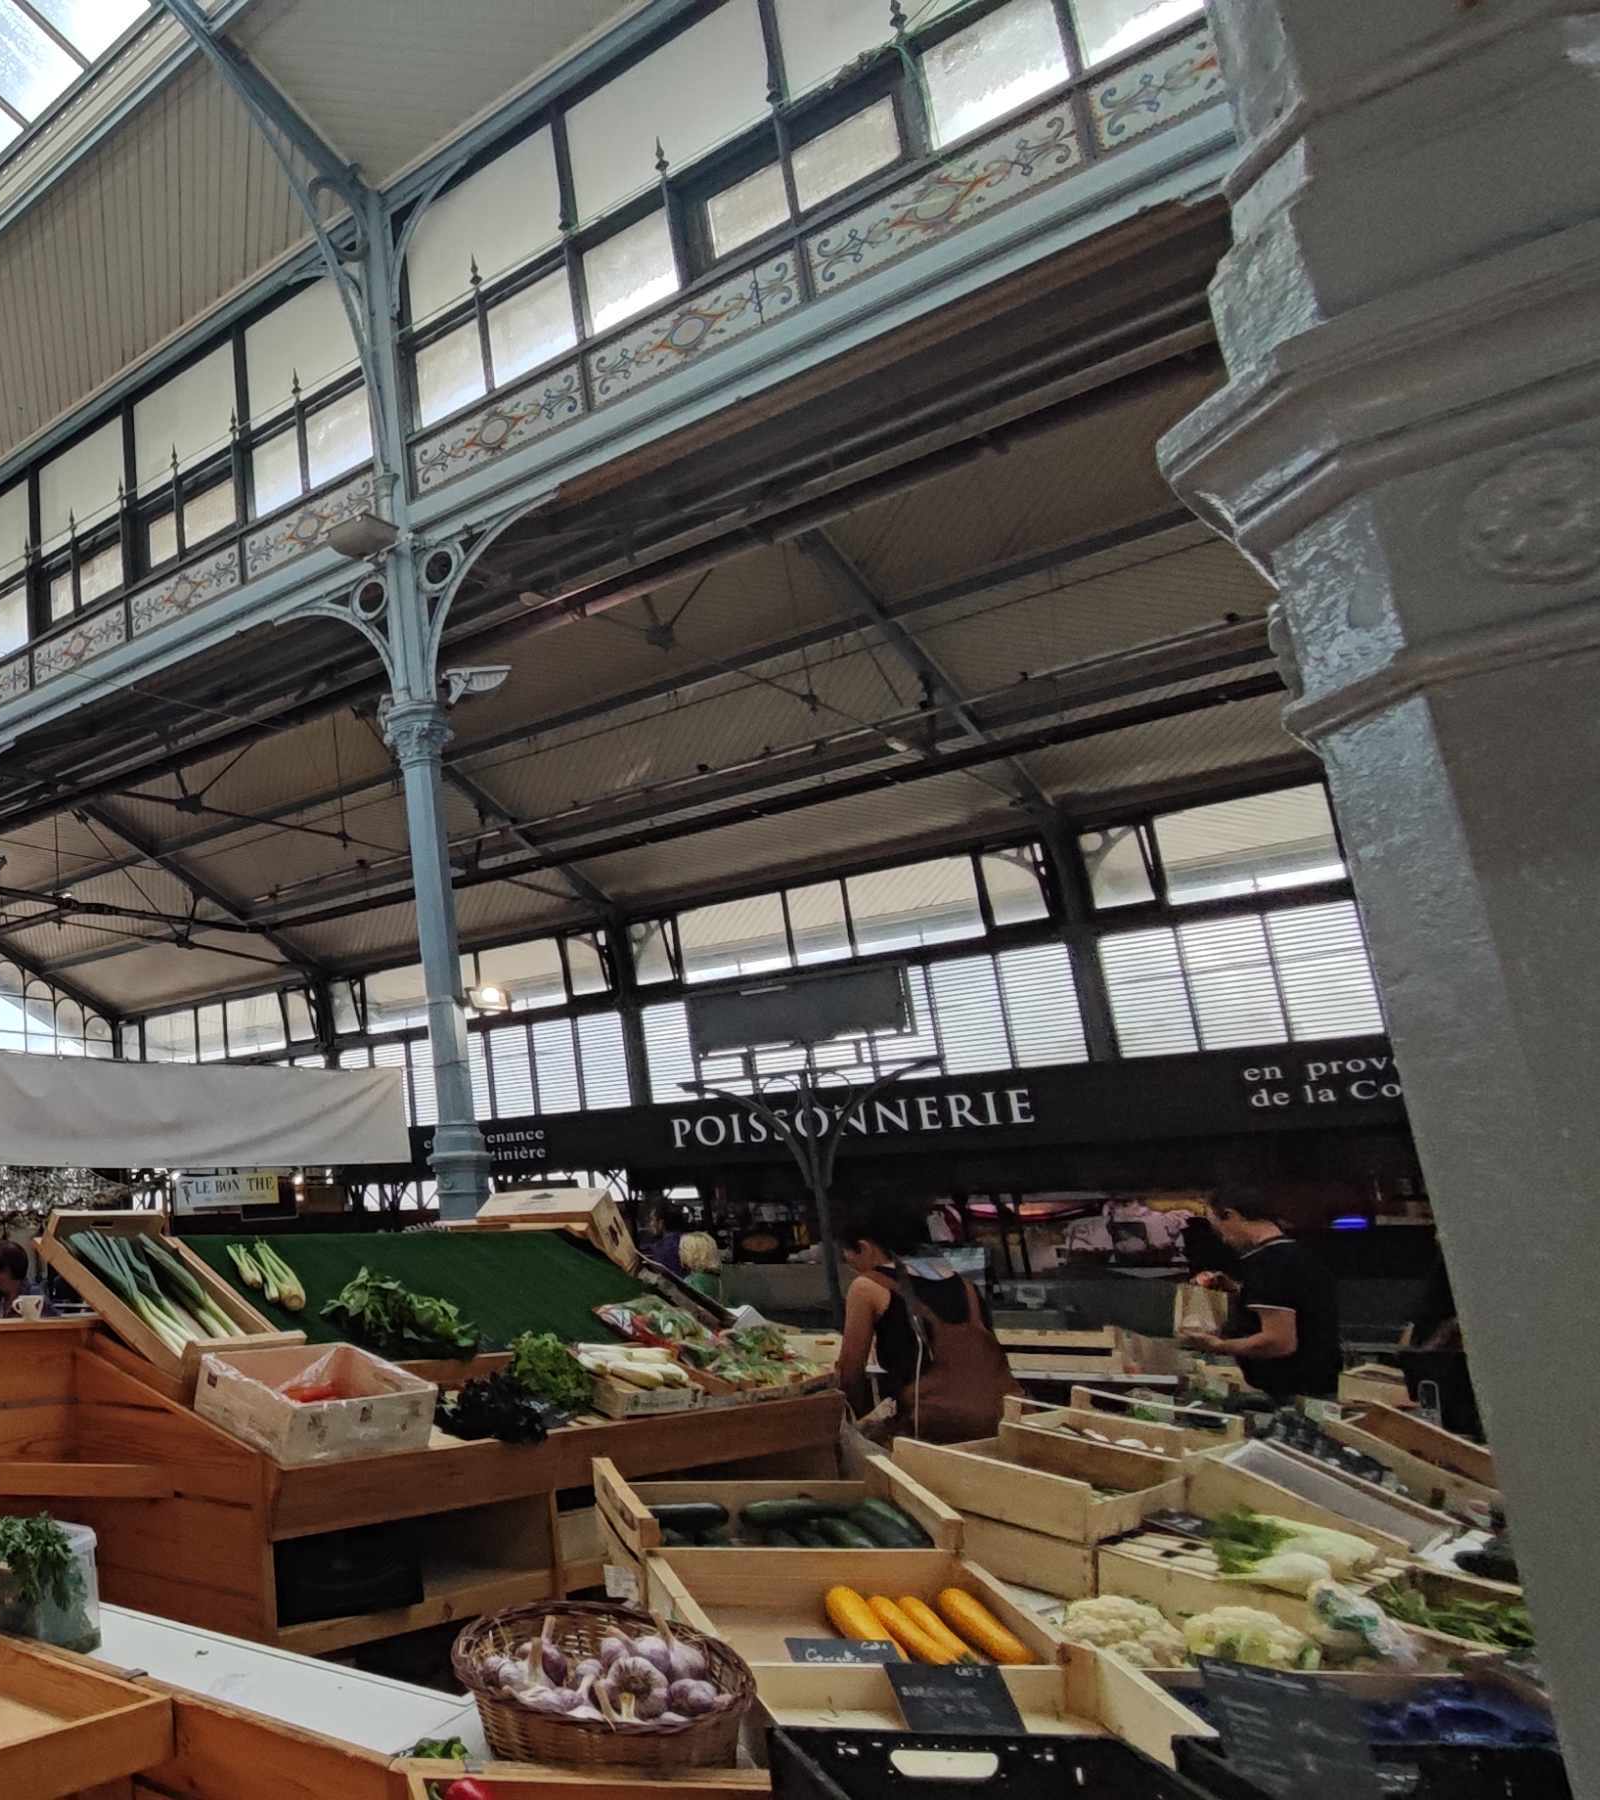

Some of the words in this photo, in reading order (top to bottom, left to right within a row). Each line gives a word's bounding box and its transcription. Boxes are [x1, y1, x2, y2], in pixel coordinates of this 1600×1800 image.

[1243, 1066, 1283, 1081] en
[1306, 1057, 1387, 1081] prov
[1251, 1089, 1290, 1107] de
[1304, 1085, 1337, 1103] la
[1350, 1080, 1400, 1100] Co
[671, 1089, 1035, 1149] POISSONNERIE
[486, 1130, 545, 1144] enance
[195, 1181, 211, 1195] LE
[215, 1179, 241, 1194] BON
